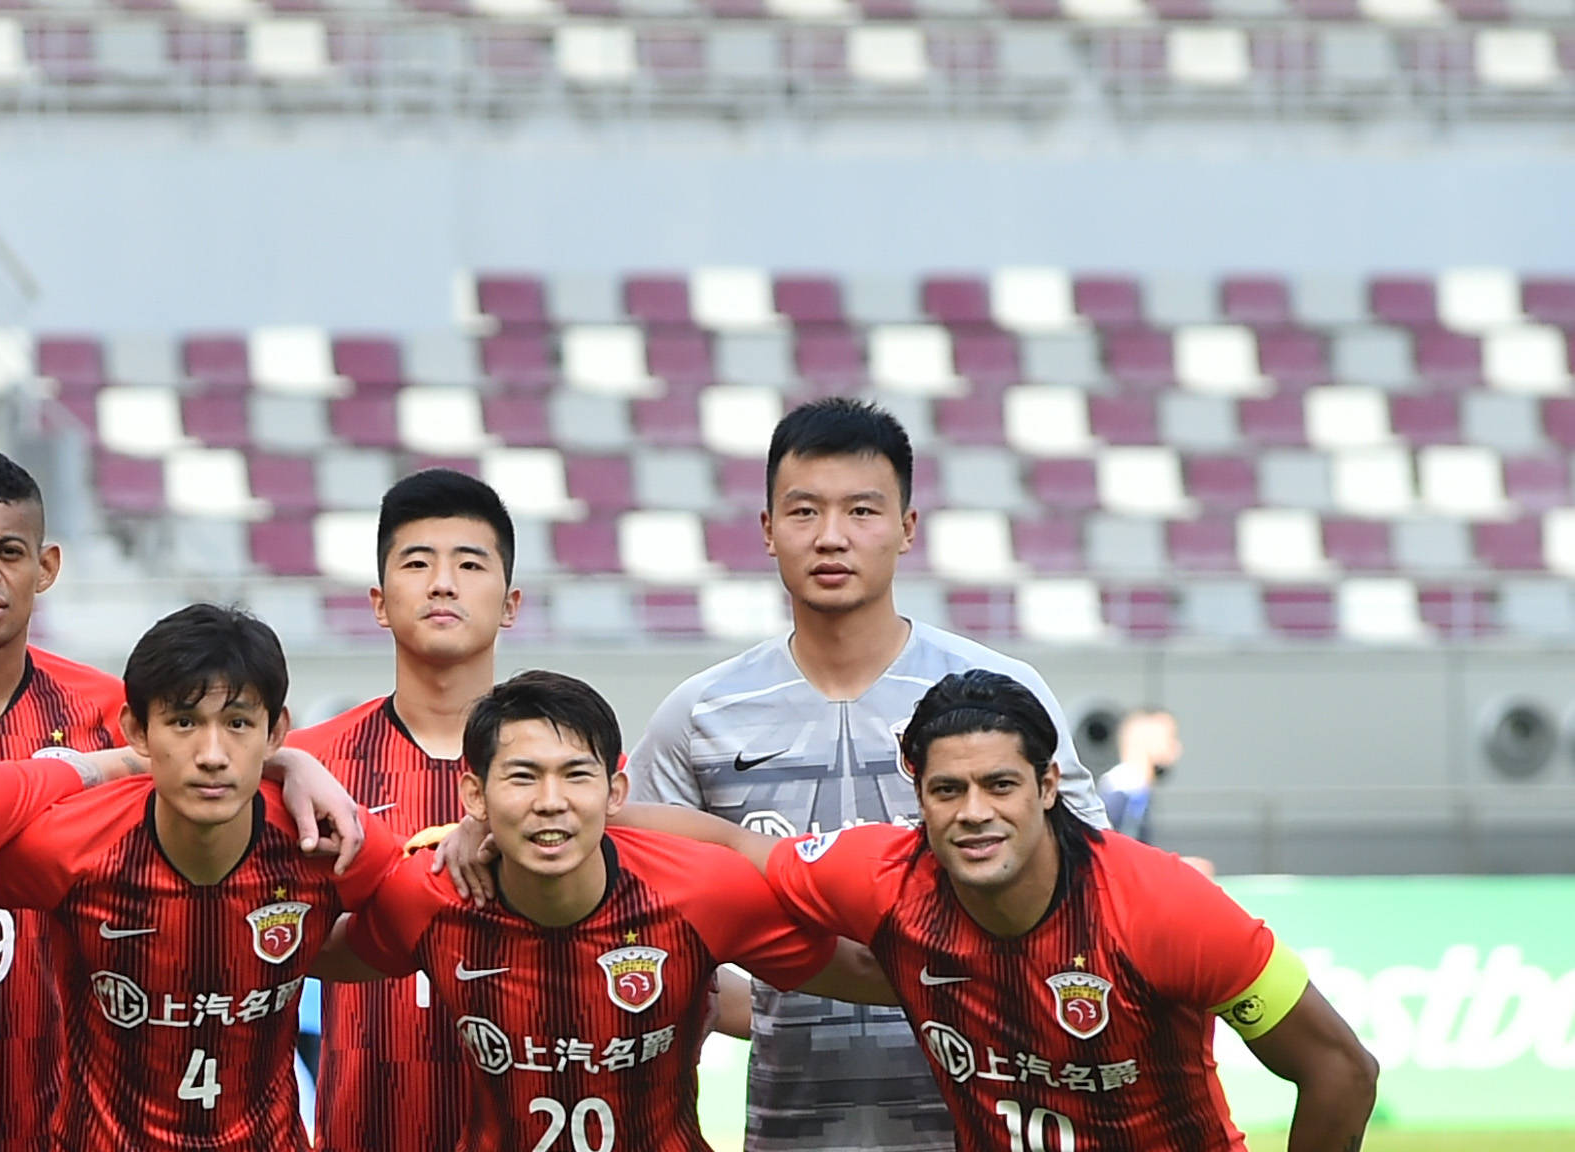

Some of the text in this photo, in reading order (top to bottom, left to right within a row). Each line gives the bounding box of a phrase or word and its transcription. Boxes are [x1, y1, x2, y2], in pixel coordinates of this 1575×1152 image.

[94, 974, 144, 1024] MG
[514, 1024, 675, 1074] 上汽名爵
[977, 1047, 1139, 1092] 上汽名爵
[177, 1049, 221, 1109] 4
